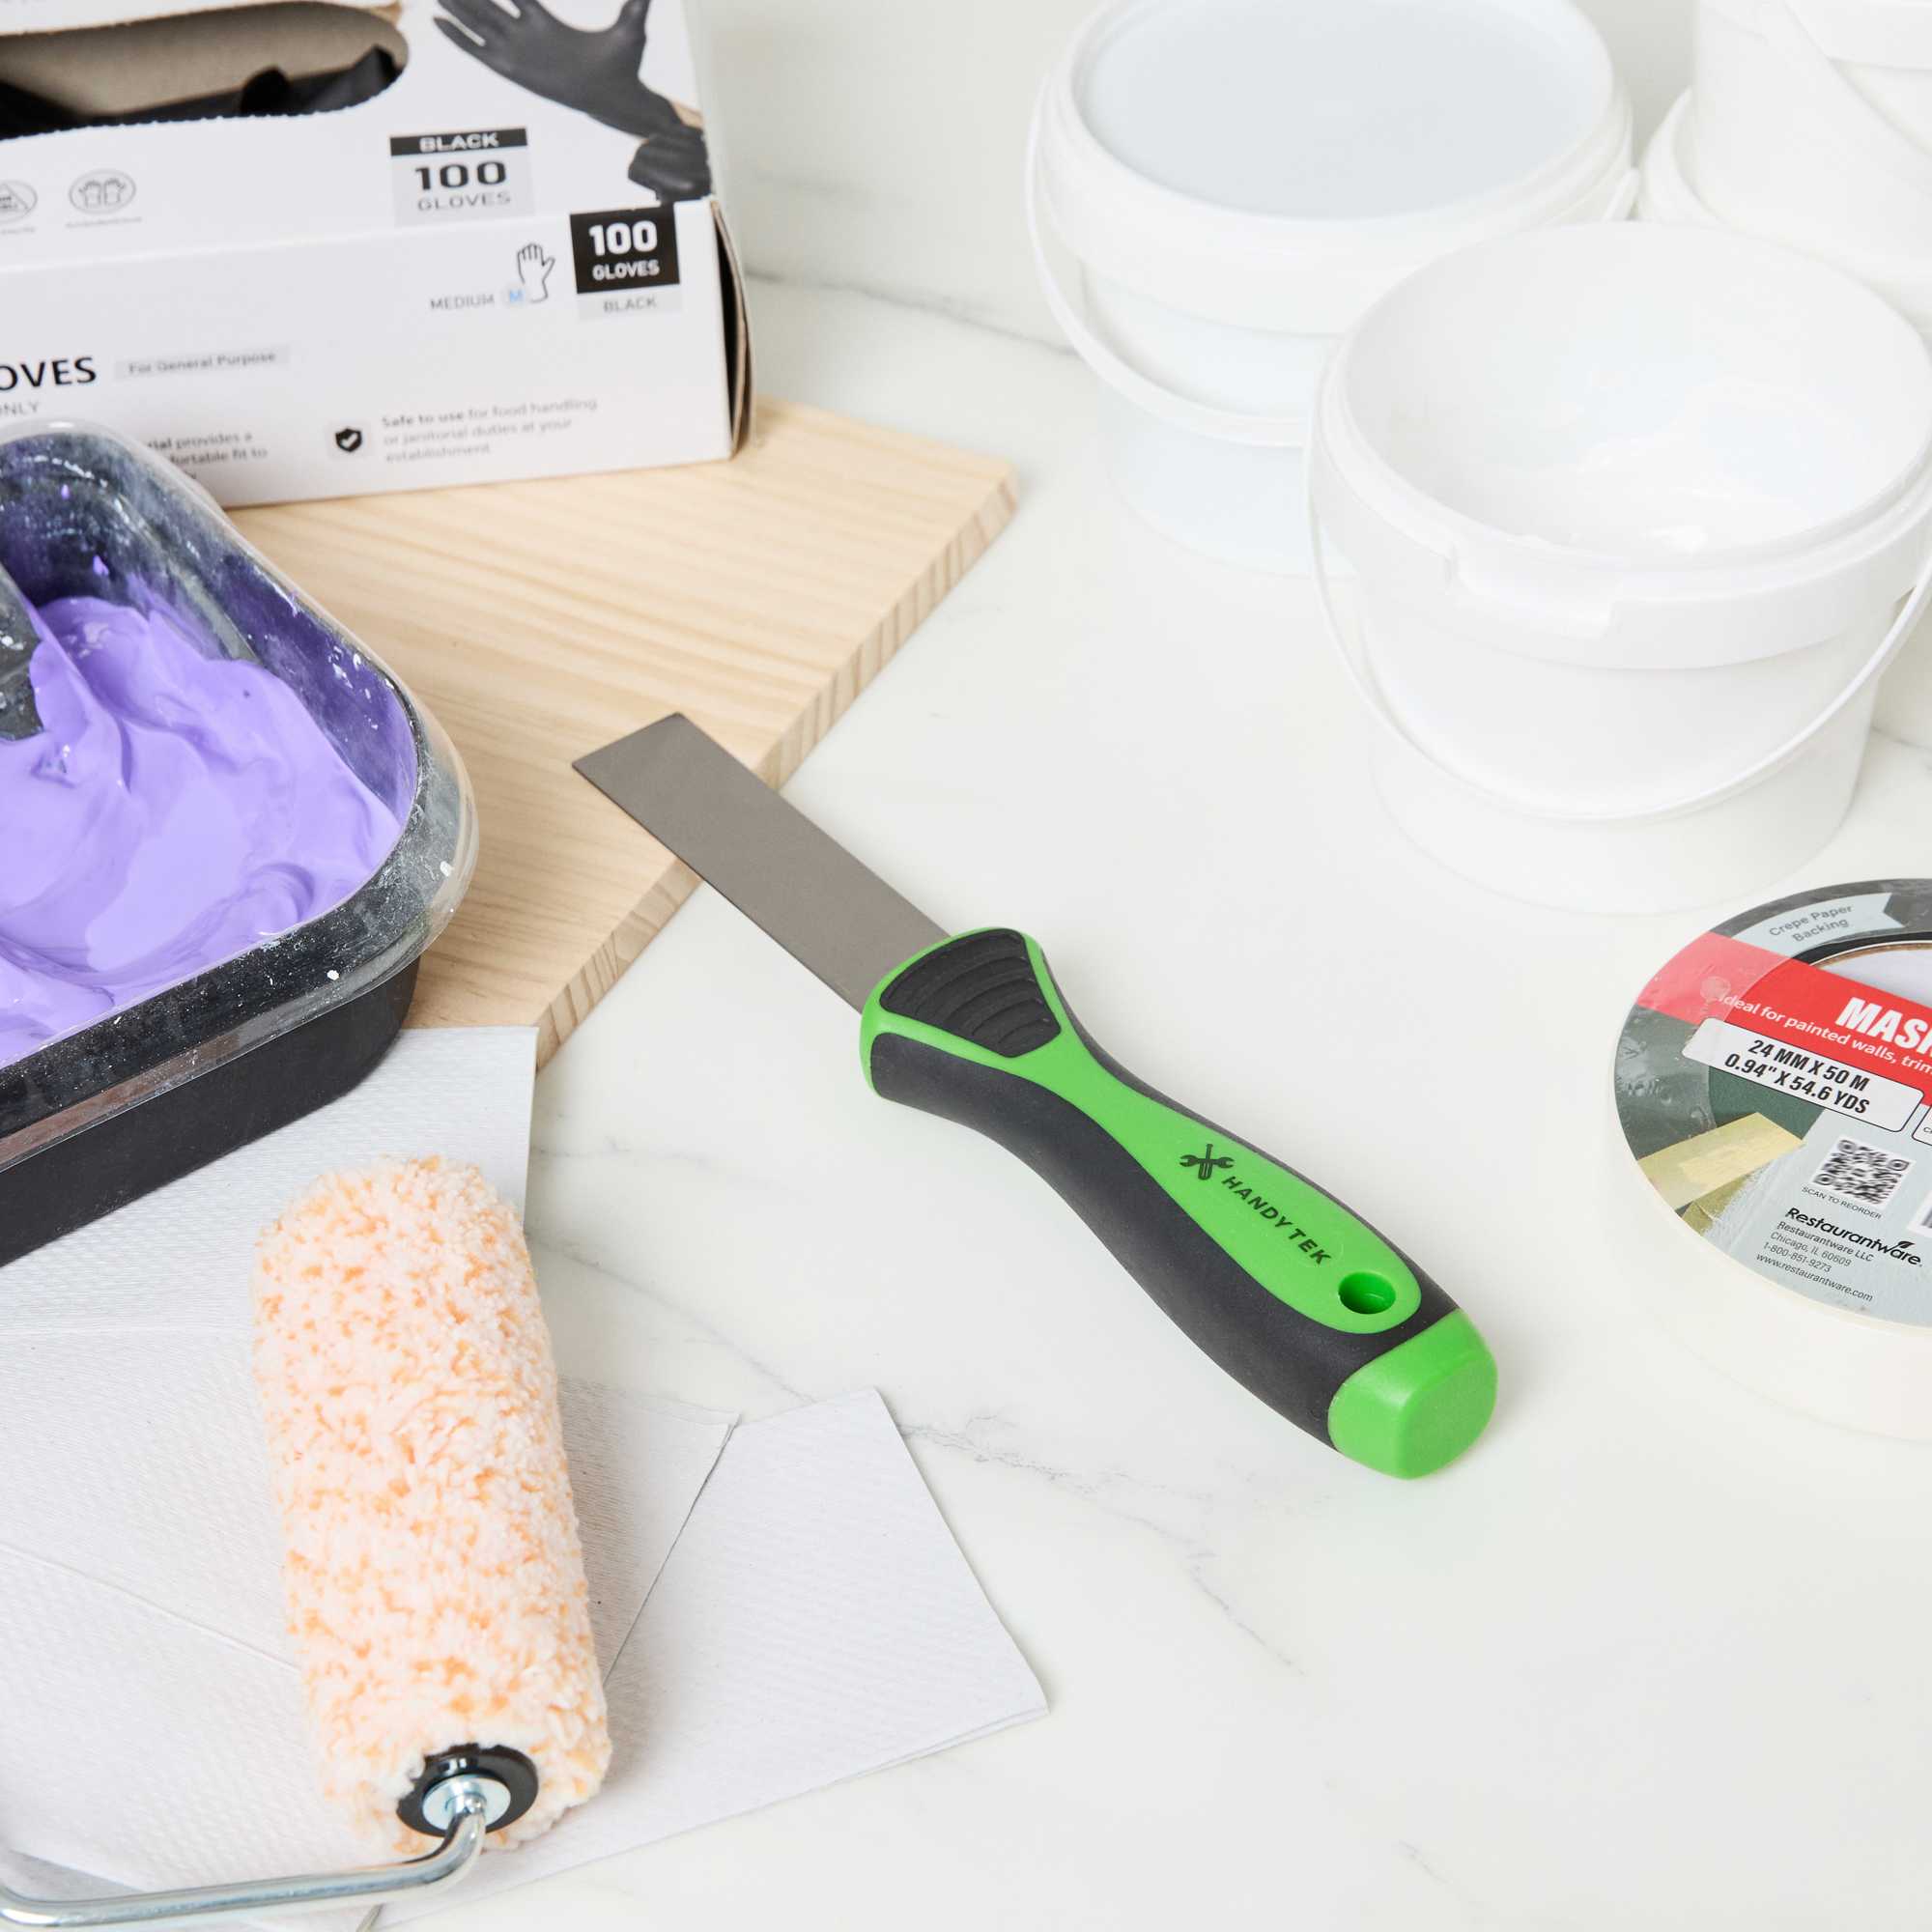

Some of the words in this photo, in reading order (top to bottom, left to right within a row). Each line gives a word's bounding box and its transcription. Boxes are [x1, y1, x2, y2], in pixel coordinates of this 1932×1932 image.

[419, 132, 499, 154] BLACK
[415, 160, 506, 191] 100
[417, 192, 511, 212] GLOVES
[588, 220, 658, 256] 100
[592, 259, 660, 281] GLOVES
[430, 293, 495, 311] MEDIUM
[509, 290, 523, 303] M
[603, 297, 657, 313] BLACK
[128, 362, 152, 375] For
[156, 357, 213, 373] General
[217, 352, 276, 367] Purpose
[0, 401, 39, 416] NLY
[383, 414, 413, 428] Safe
[418, 413, 434, 425] to
[439, 412, 464, 424] use
[469, 408, 487, 420] for
[492, 403, 527, 416] food
[530, 398, 598, 413] handling
[1769, 916, 1809, 937] Crepe
[1811, 905, 1853, 922] Paper
[1793, 919, 1849, 942] Backing
[1719, 992, 1761, 1014] Ideal
[1761, 1007, 1785, 1023] for
[1784, 1017, 1851, 1046] painted
[1852, 1039, 1896, 1064] walls,
[1747, 1039, 1772, 1058] 24
[1774, 1048, 1808, 1071] MM
[1808, 1061, 1824, 1076] X
[1823, 1065, 1850, 1085] 50
[1849, 1074, 1870, 1092] M
[1724, 1053, 1776, 1078] 0.94"
[1775, 1070, 1791, 1087] X
[1789, 1075, 1832, 1101] 54.6
[1834, 1090, 1870, 1114] YDS
[1802, 1186, 1826, 1200] SCAN
[1828, 1195, 1839, 1204] TO
[1840, 1200, 1883, 1220] REORDER
[1770, 1231, 1808, 1253] Chicago,
[1810, 1246, 1820, 1257] IL
[1821, 1251, 1852, 1267] 60609
[1776, 1221, 1854, 1255] Restaurantware
[1855, 1249, 1875, 1263] LLC
[1785, 1208, 1921, 1266] Restaurantware
[1763, 1242, 1832, 1273] 1-800-851-9273
[1756, 1254, 1873, 1302] www.restaurantware.com
